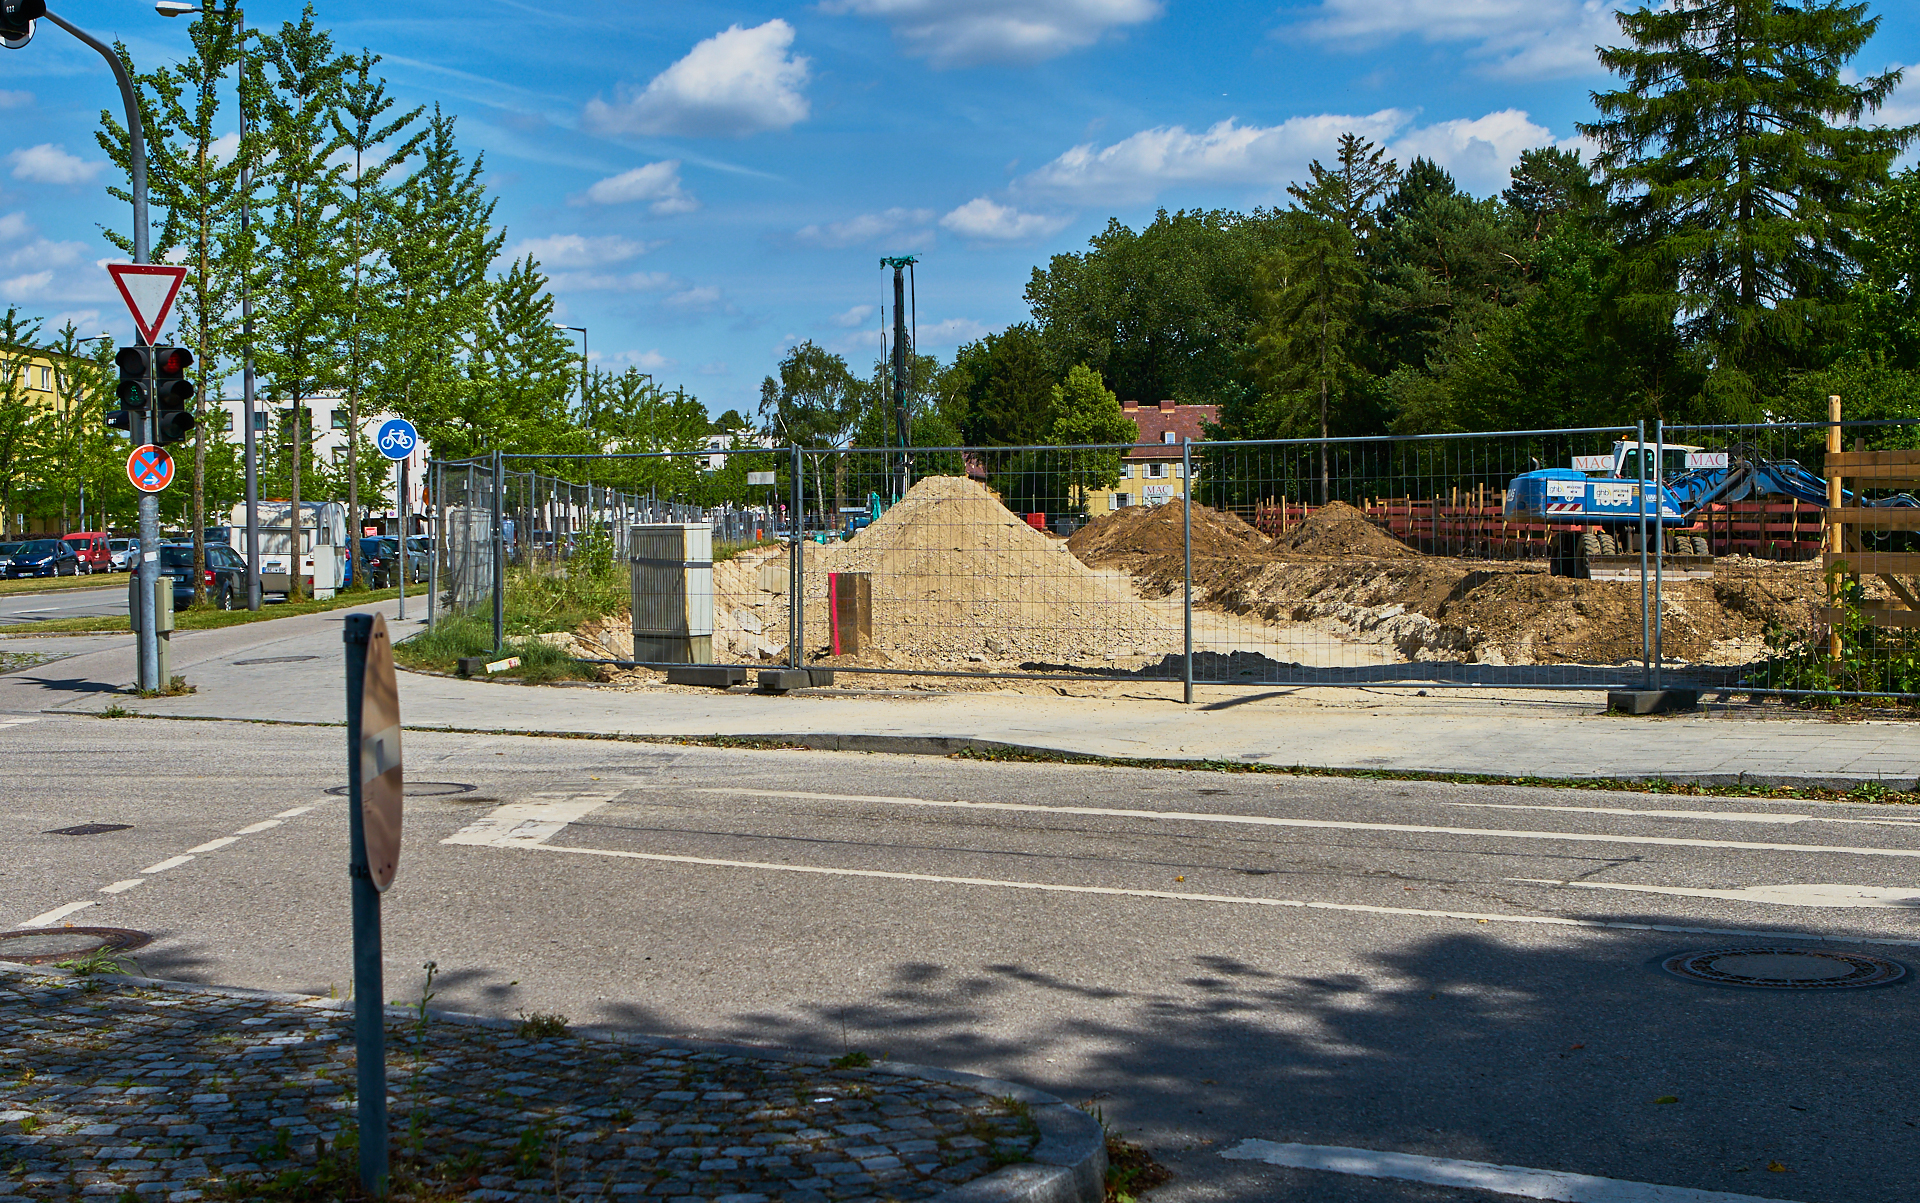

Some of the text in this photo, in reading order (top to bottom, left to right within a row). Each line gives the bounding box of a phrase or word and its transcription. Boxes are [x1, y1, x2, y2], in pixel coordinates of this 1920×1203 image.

[1575, 456, 1612, 468] MAC
[1691, 454, 1725, 465] MAC
[1147, 485, 1169, 493] MAC
